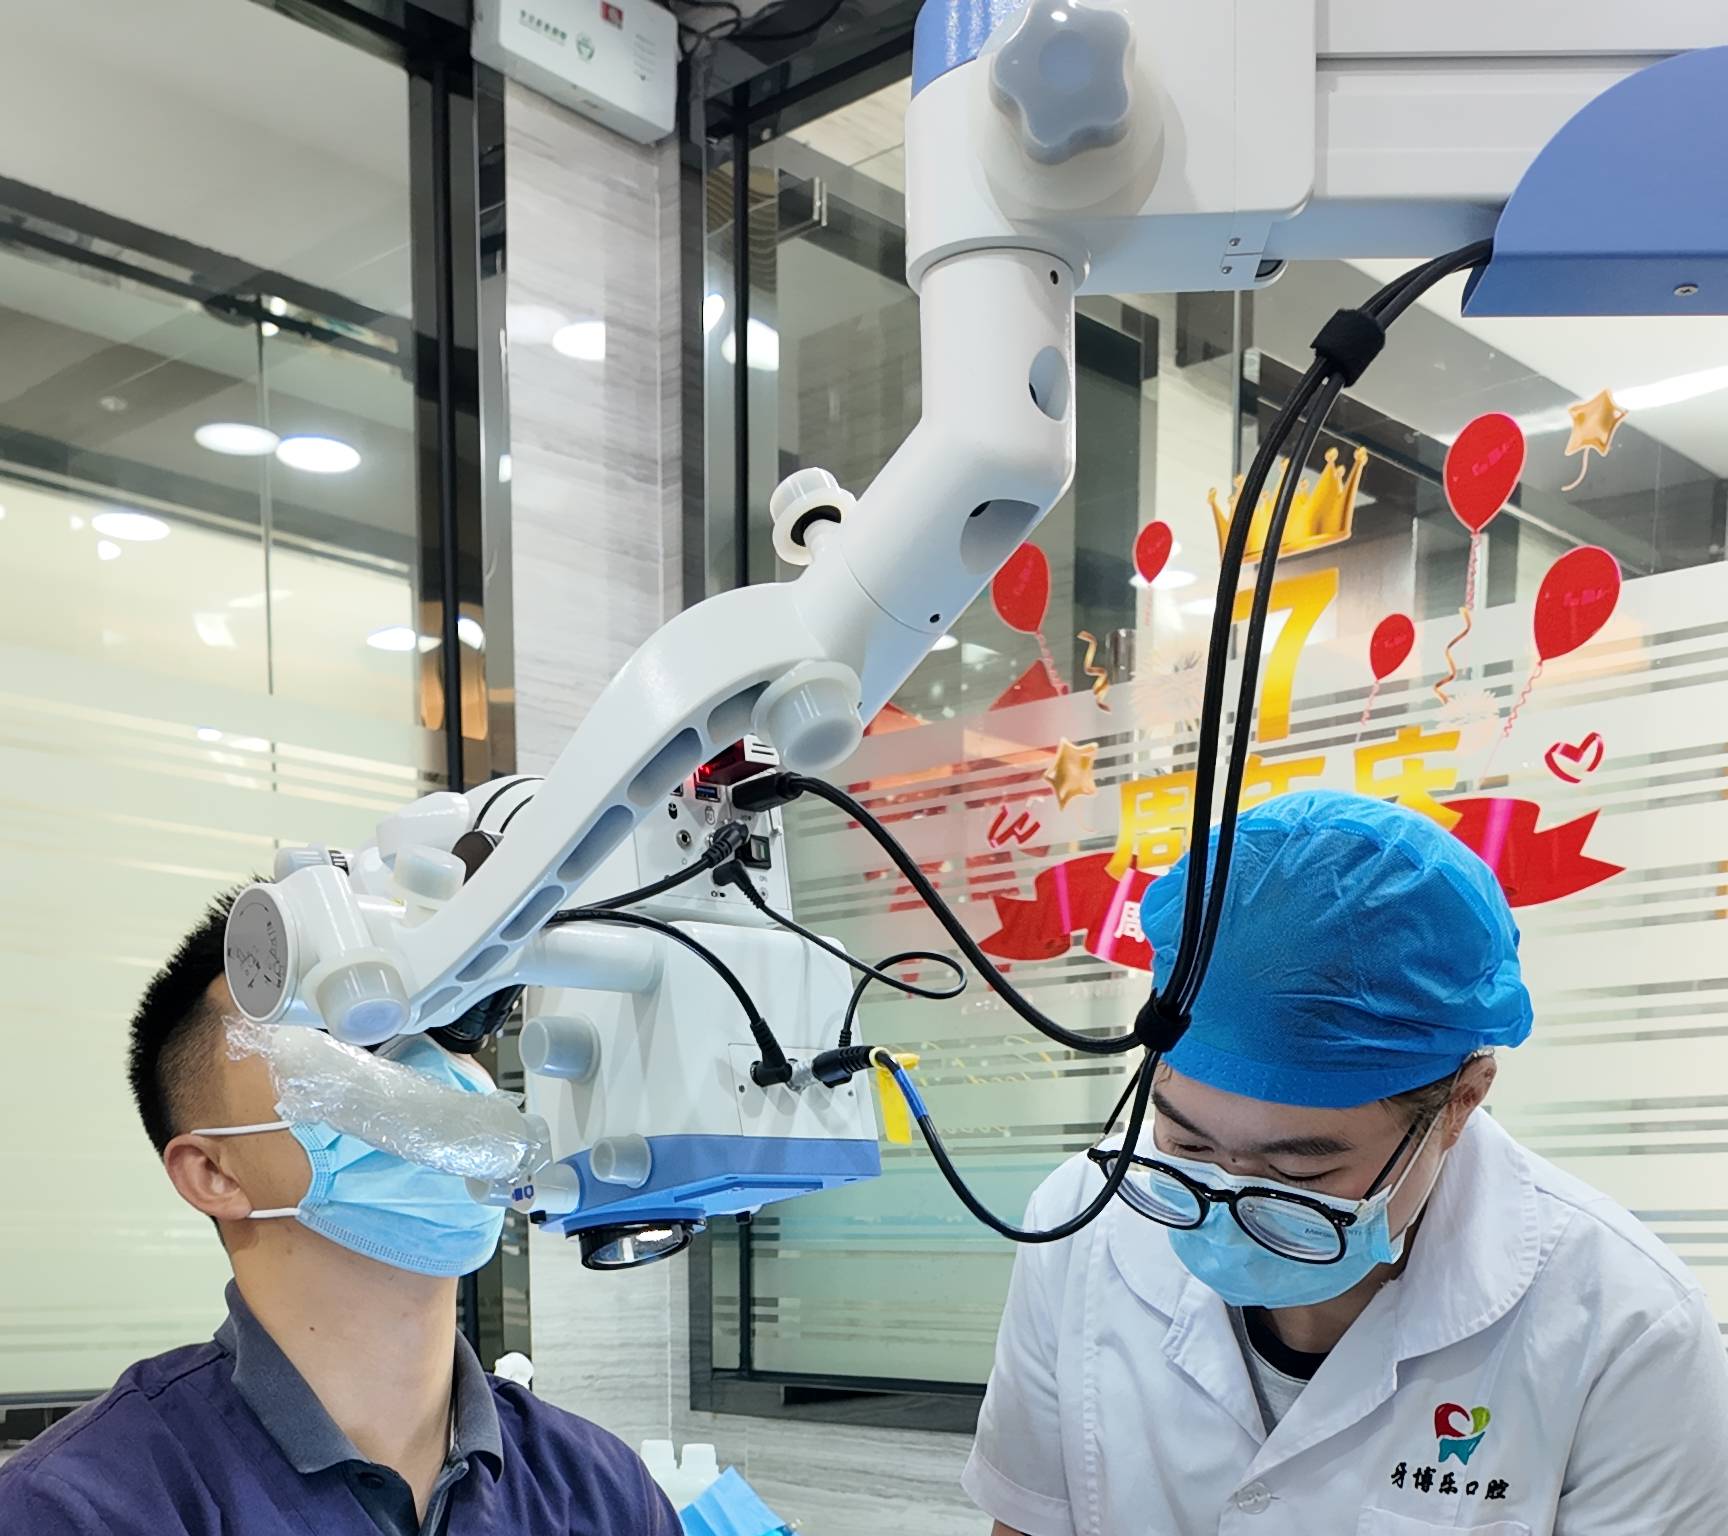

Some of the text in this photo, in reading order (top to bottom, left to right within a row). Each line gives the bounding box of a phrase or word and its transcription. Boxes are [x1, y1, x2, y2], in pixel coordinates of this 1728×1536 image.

[1233, 566, 1339, 743] 7
[1391, 1461, 1510, 1500] 牙博乐口腔
